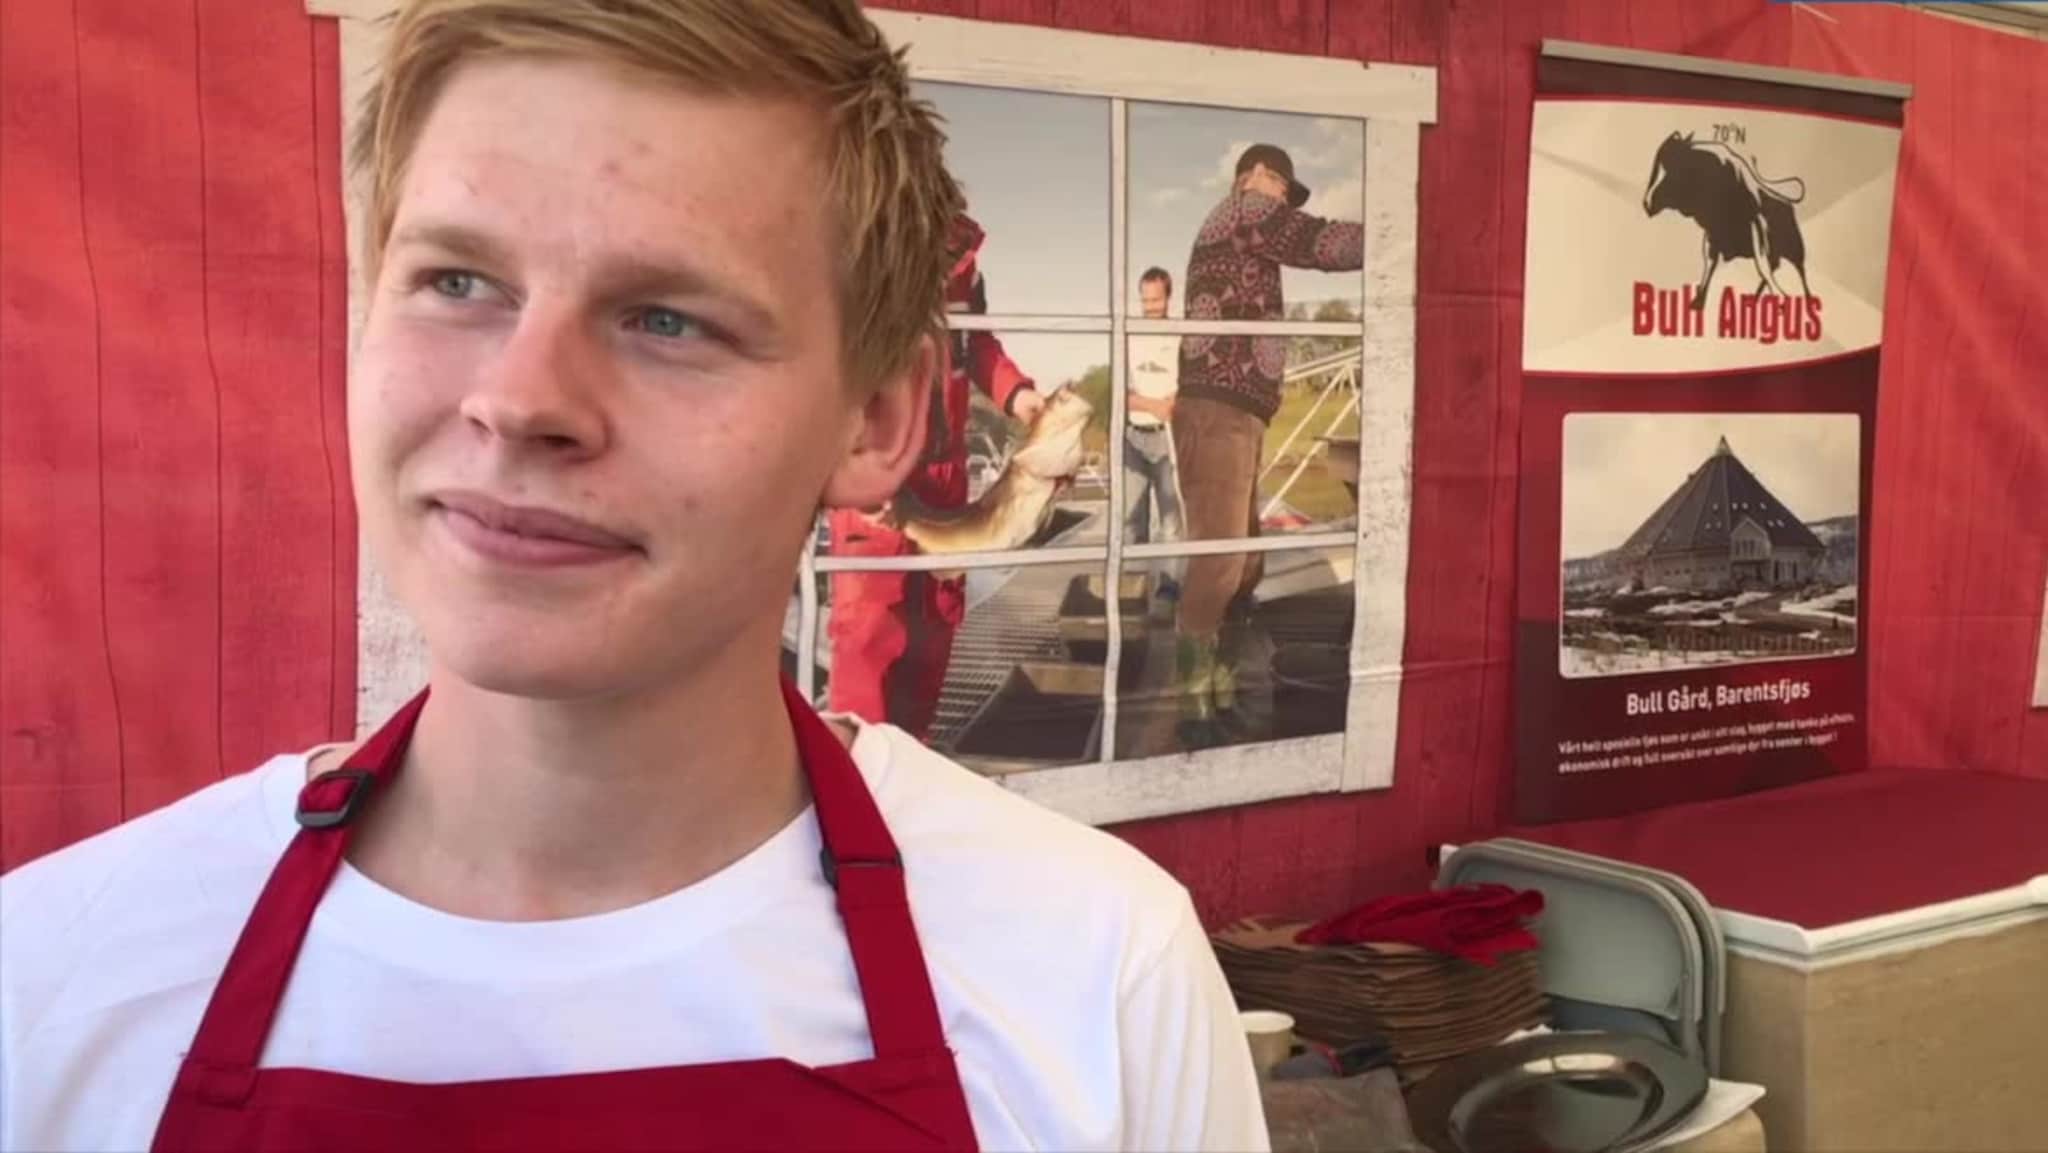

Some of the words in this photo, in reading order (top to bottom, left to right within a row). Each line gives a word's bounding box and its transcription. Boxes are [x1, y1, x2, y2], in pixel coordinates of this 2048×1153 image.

[1632, 281, 1703, 338] Bull
[1717, 286, 1822, 344] Angus
[1626, 690, 1664, 716] Bull
[1667, 684, 1712, 712] Gård,
[1716, 678, 1811, 705] Barentsfjøs
